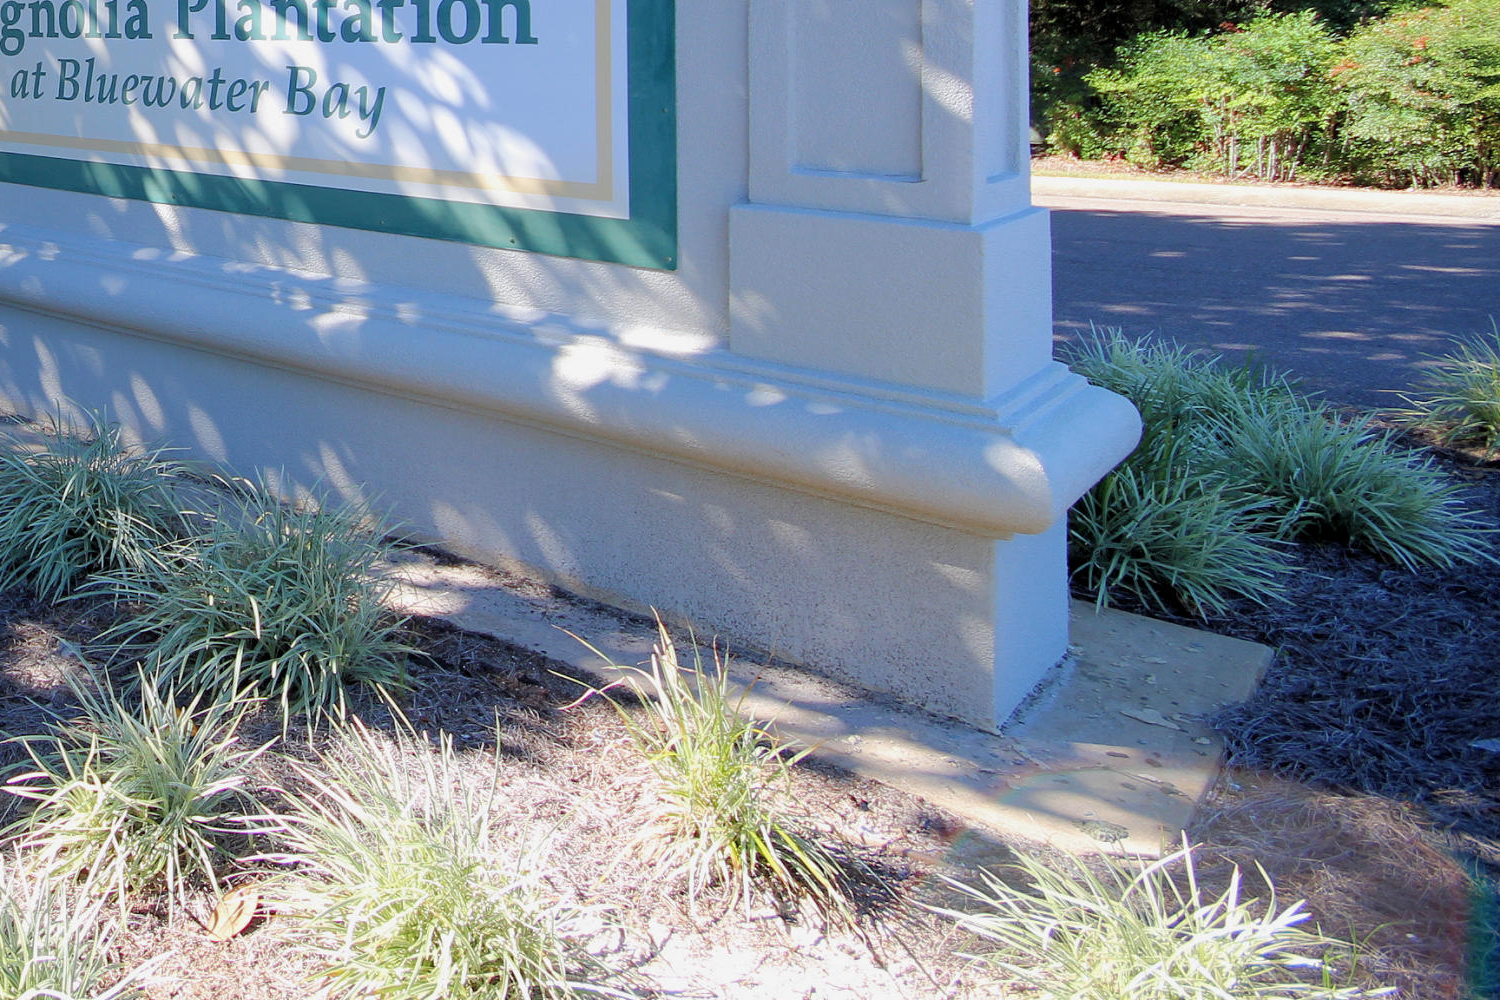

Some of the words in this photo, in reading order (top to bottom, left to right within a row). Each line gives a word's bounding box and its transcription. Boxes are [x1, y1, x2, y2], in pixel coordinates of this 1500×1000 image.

[11, 61, 46, 99] at
[55, 57, 269, 115] Bluewater
[282, 65, 386, 139] Bay
